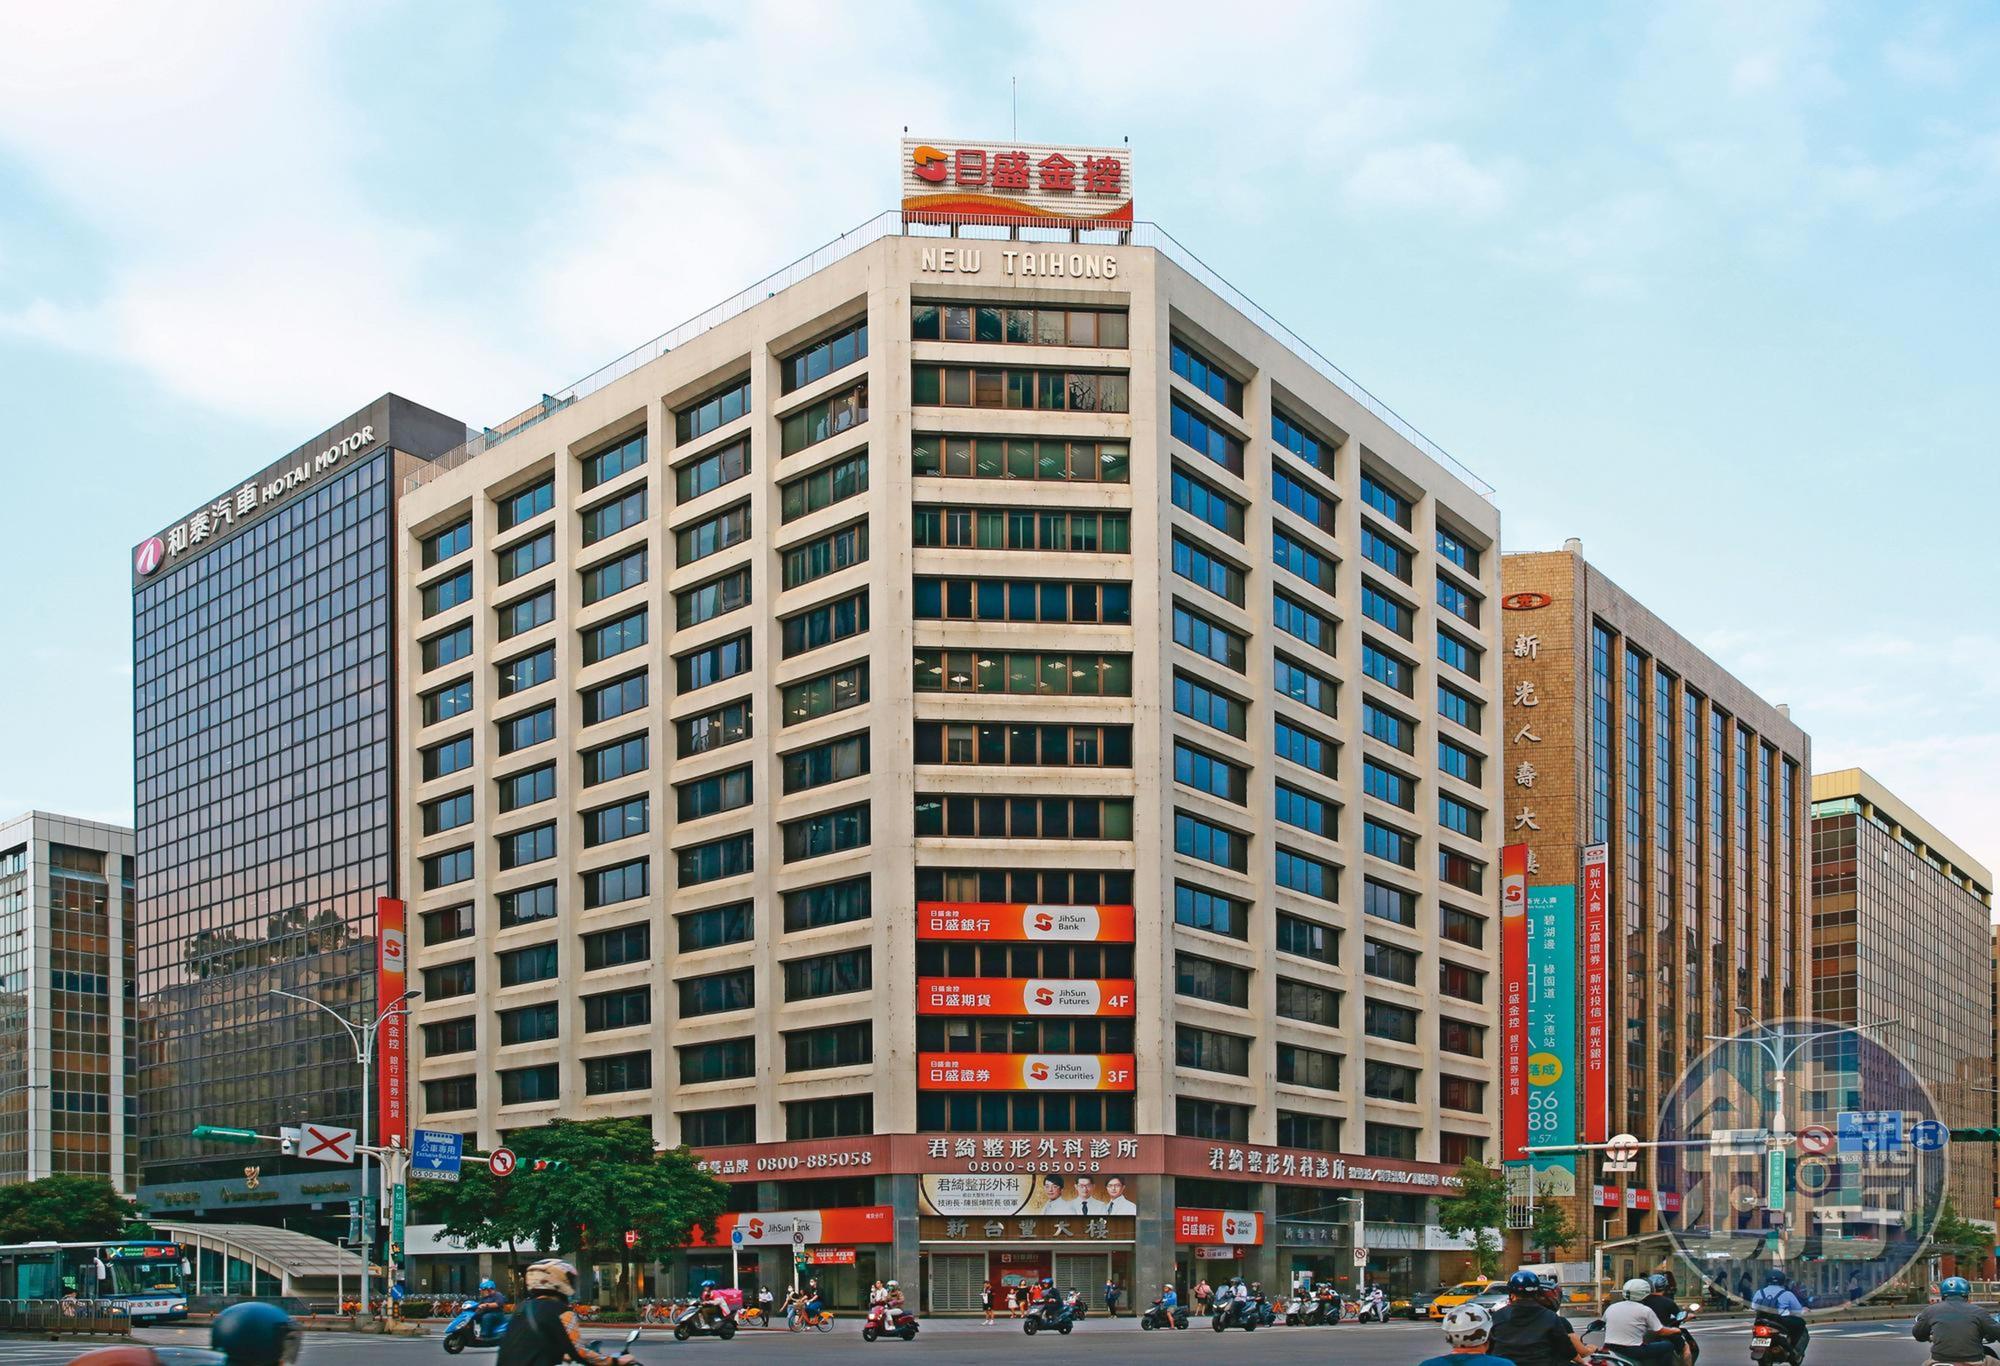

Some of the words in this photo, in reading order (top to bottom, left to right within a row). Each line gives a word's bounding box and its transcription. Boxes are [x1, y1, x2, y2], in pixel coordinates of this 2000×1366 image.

[954, 149, 1121, 194] 日盛金控
[921, 247, 982, 274] NEW
[1002, 250, 1119, 279] TAIHONG
[262, 461, 311, 504] HOTAI
[315, 424, 376, 473] MOTOR
[167, 481, 258, 557] 和泰汽車
[931, 919, 990, 931] 日盛銀行
[1058, 915, 1085, 923] JihSun
[931, 994, 991, 1007] 日盛期貨
[1107, 995, 1129, 1007] 4F
[1508, 982, 1520, 1028] 日盛金控
[931, 1069, 990, 1082] 日盛證券
[1054, 1072, 1094, 1080] Securities
[1107, 1070, 1129, 1083] 3F
[928, 1138, 1138, 1159] 君綺整形外科診所
[757, 1151, 872, 1172] 0800-885058
[968, 1161, 1101, 1172] 0800-885058
[1208, 1147, 1345, 1180] 君綺整形外科診所
[938, 1178, 1020, 1191] 君綺整形外科
[768, 1223, 790, 1233] JihSun
[946, 1218, 1109, 1239] 新台豐大樓
[1182, 1223, 1215, 1236] 日盛銀行
